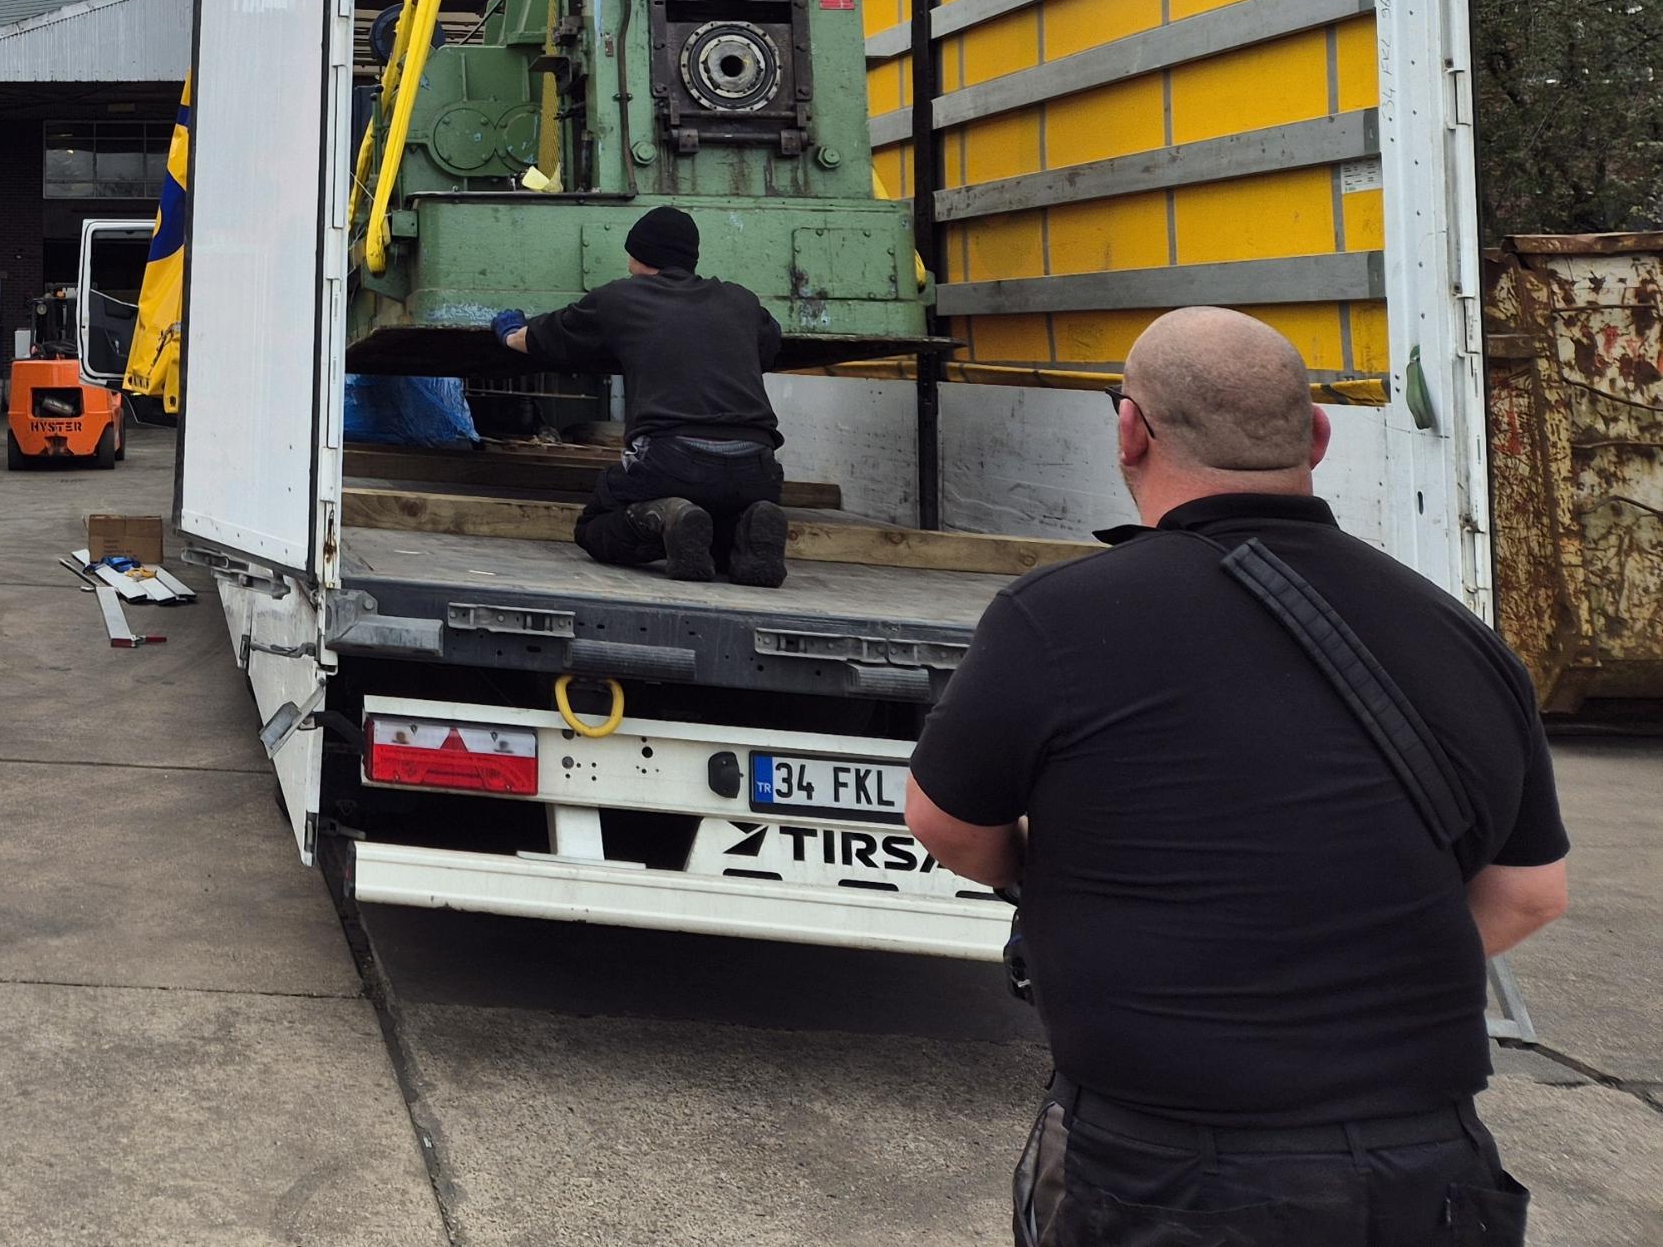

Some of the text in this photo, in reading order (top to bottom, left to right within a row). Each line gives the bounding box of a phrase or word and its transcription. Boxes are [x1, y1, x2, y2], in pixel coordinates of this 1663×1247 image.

[30, 421, 82, 432] HYSTER
[757, 781, 772, 794] TR
[775, 762, 895, 807] 34 FKL
[779, 825, 946, 873] TIRS
